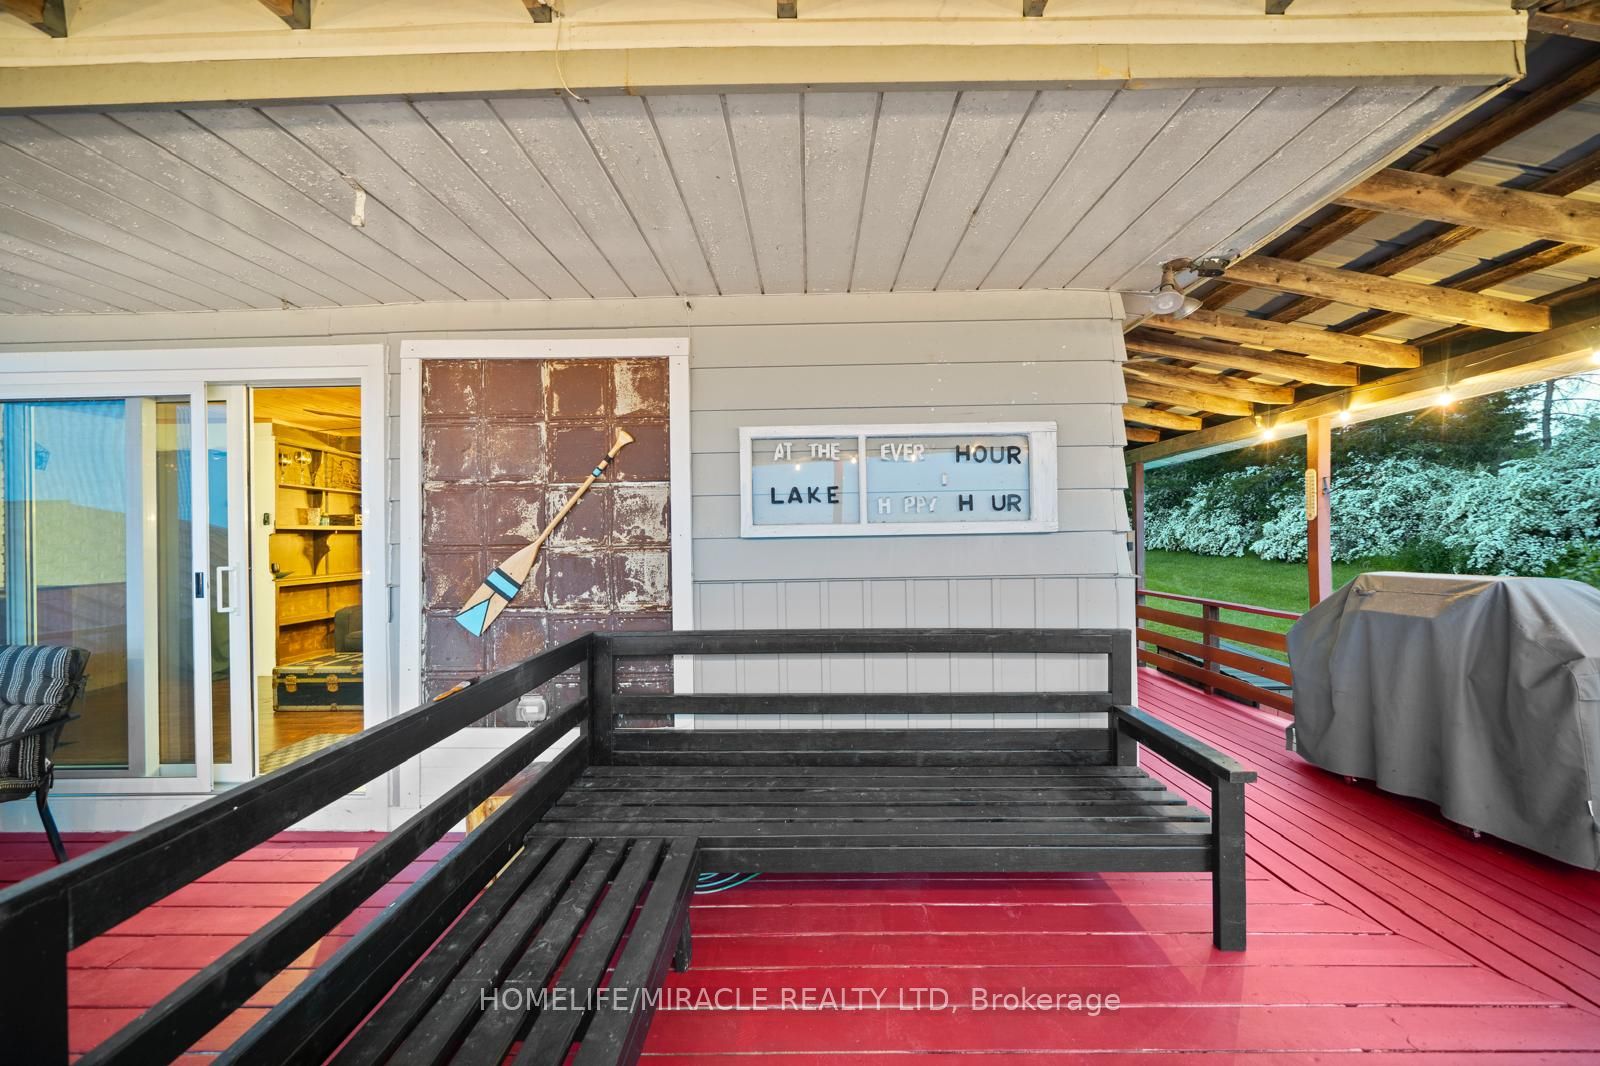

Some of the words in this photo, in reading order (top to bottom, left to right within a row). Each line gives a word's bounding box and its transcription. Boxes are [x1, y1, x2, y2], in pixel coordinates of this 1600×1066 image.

[774, 442, 793, 461] AT
[808, 442, 841, 461] THE
[955, 445, 1023, 465] HOUR
[770, 486, 840, 504] LAKE
